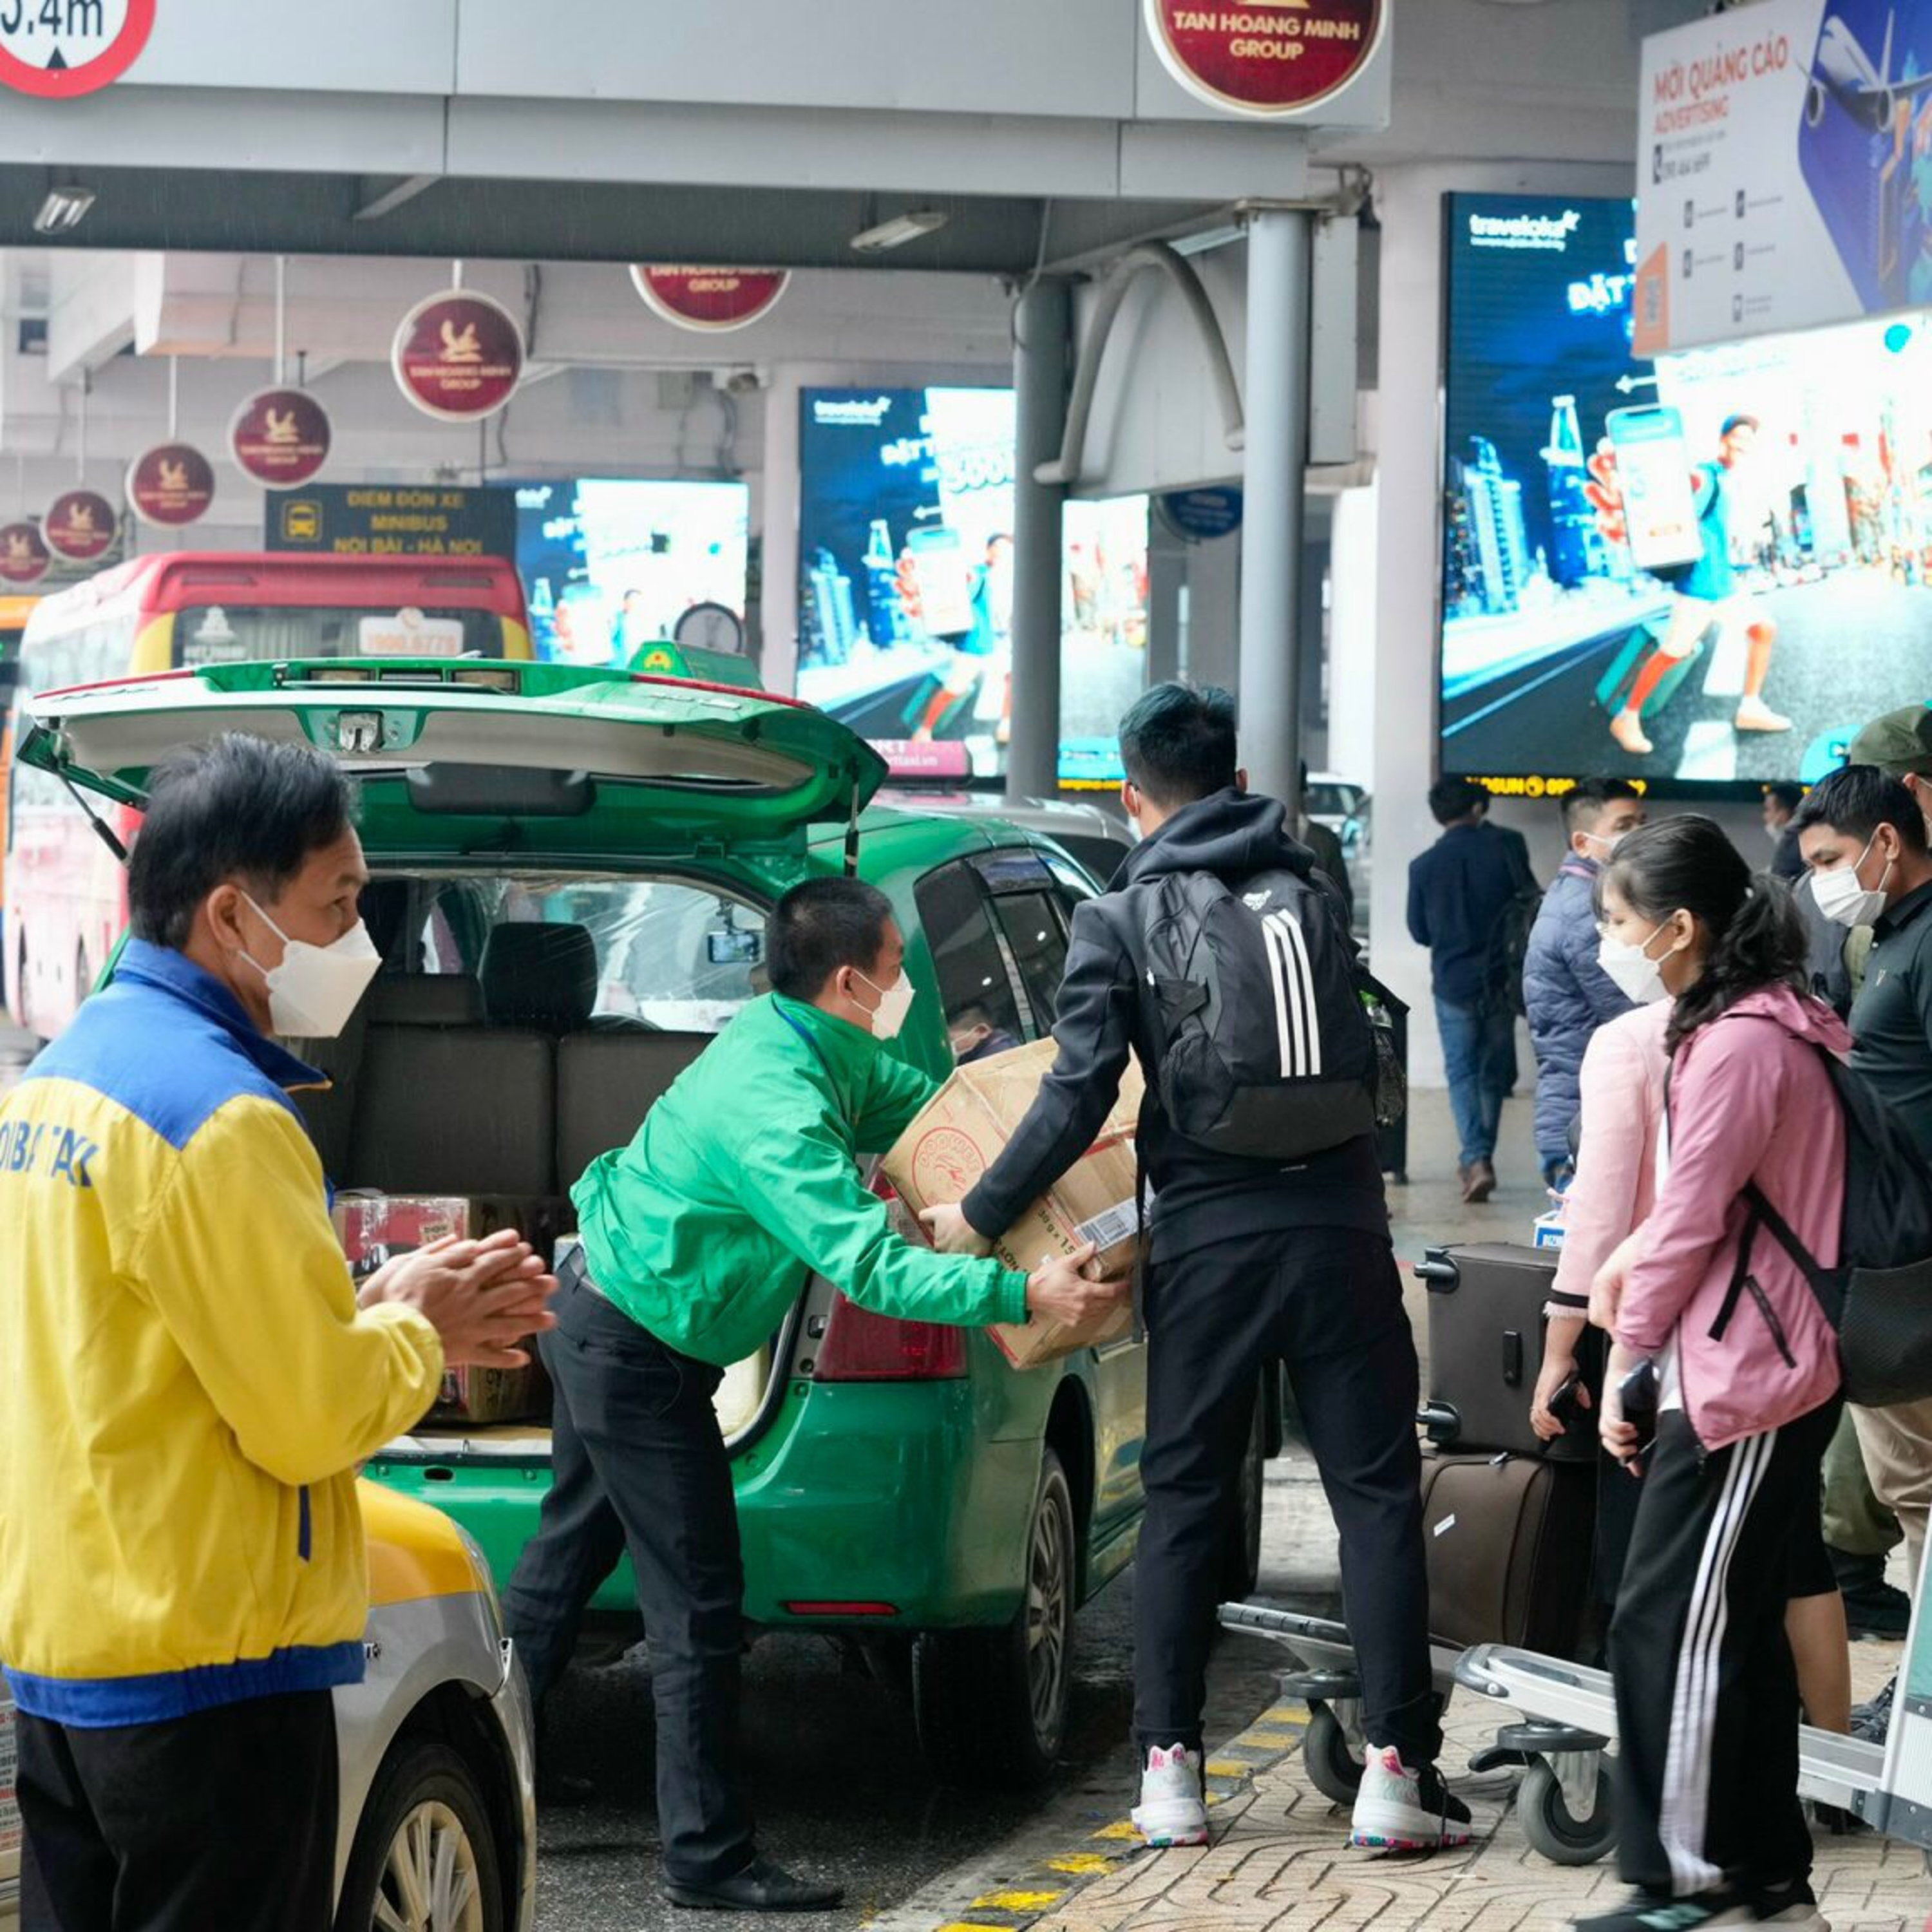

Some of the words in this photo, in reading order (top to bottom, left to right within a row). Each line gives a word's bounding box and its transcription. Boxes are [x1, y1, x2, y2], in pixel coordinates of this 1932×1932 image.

[1173, 11, 1216, 30] TAN
[1220, 13, 1300, 36] HOANG
[1304, 19, 1359, 40] MINH
[1229, 38, 1303, 60] GROUP
[688, 278, 739, 293] GROUP
[372, 515, 448, 531] MINIBUS
